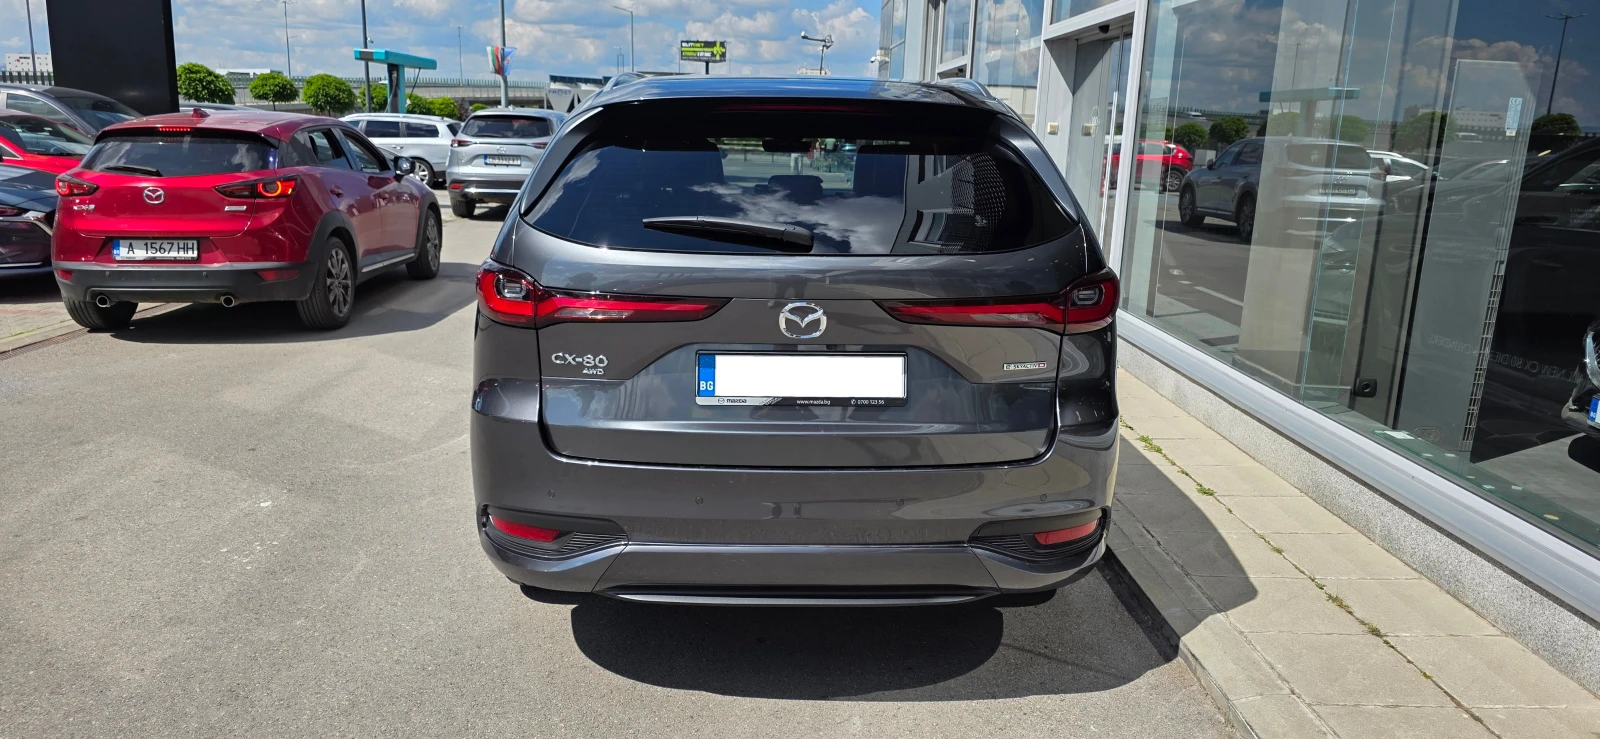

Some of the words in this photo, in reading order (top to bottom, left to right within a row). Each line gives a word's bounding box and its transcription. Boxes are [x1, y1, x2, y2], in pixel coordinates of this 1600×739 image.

[127, 242, 135, 254] A
[144, 242, 174, 254] 1567
[177, 242, 194, 254] HH
[552, 352, 608, 367] CX-80
[700, 380, 714, 391] BG
